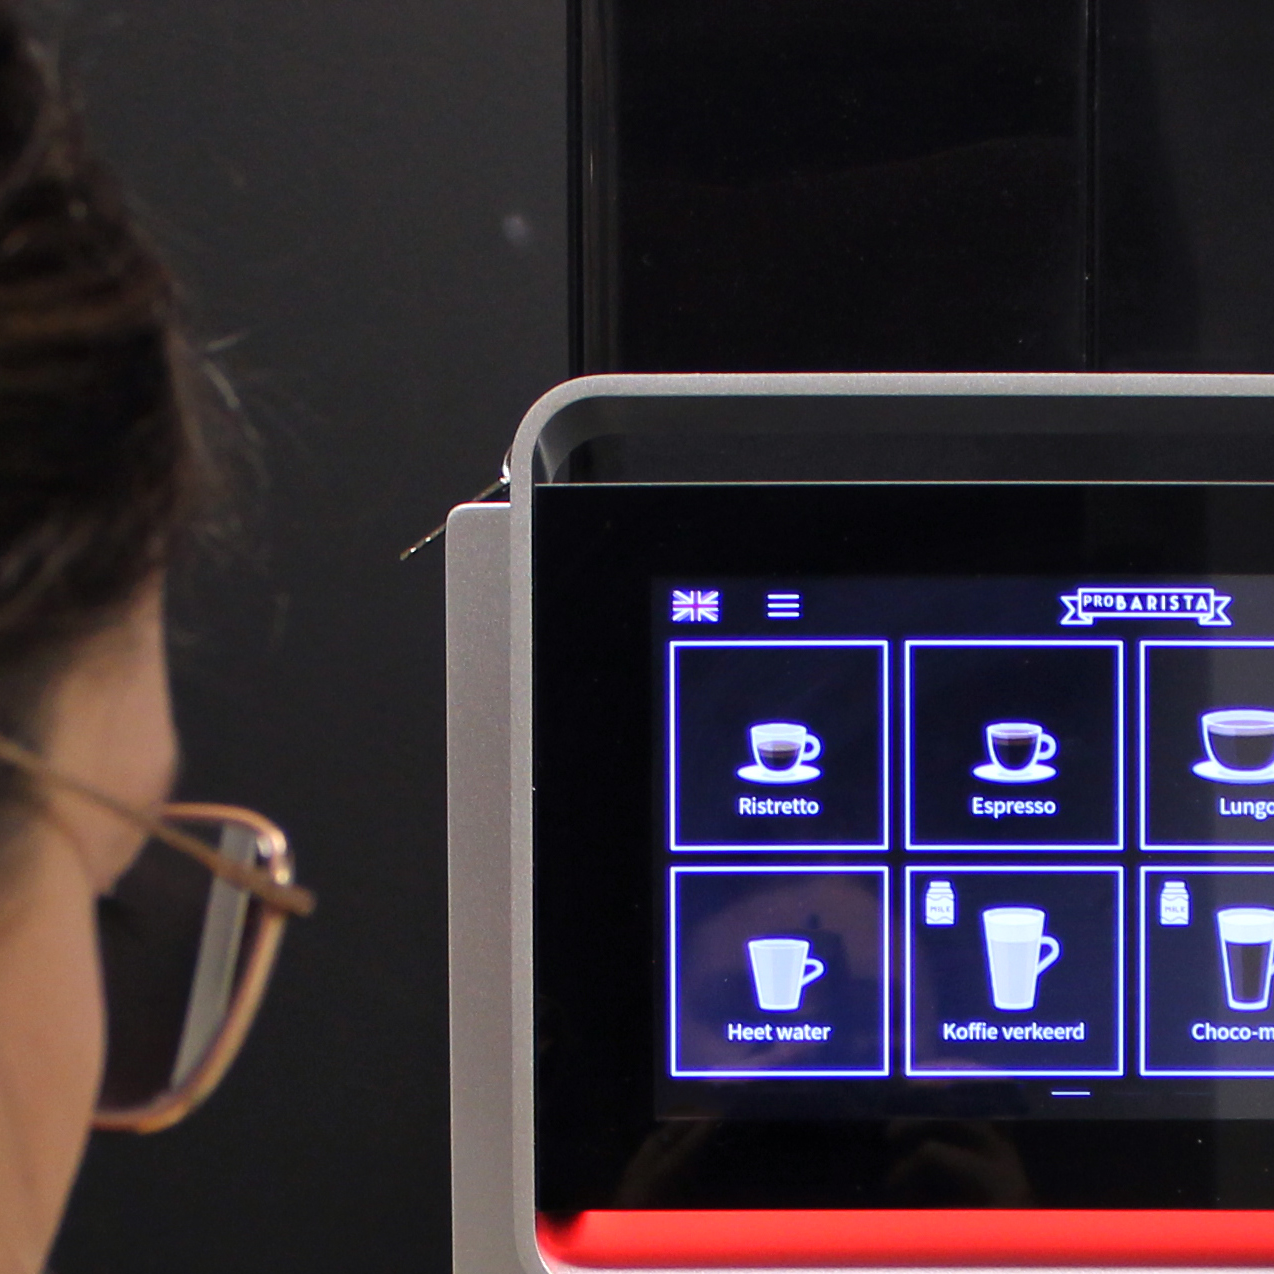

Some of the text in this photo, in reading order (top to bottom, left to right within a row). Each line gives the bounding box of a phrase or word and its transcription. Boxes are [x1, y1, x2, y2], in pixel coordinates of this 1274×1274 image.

[739, 796, 820, 815] Ristretto
[972, 796, 1056, 819] Espresso
[929, 905, 951, 913] MILK
[1164, 905, 1186, 913] MILK
[727, 1023, 832, 1041] Heet water
[943, 1021, 1085, 1041] Koffie verkeerd
